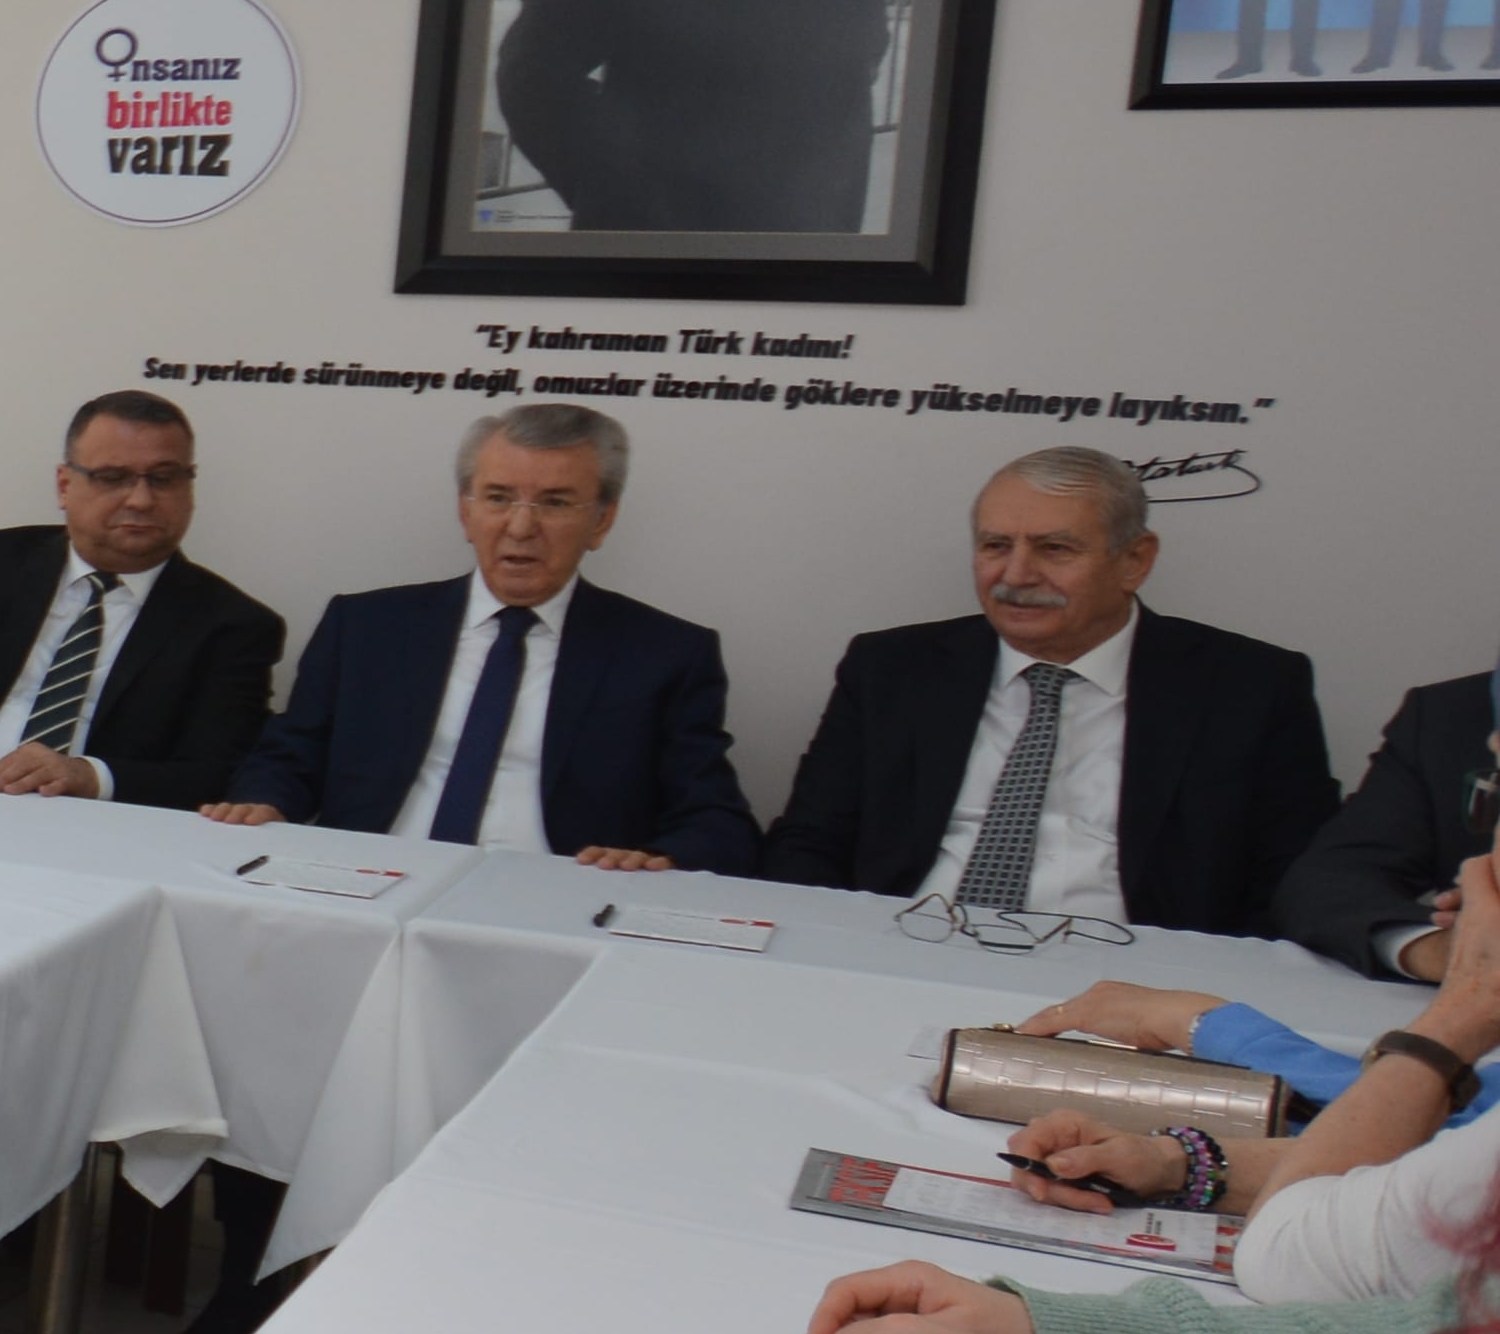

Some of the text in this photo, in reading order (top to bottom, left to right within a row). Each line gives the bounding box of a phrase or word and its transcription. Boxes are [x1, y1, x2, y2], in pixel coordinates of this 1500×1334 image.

[106, 90, 232, 130] birlikte
[107, 133, 232, 177] varız
[527, 326, 668, 353] kahraman
[678, 328, 744, 356] Türk
[750, 331, 855, 360] kadını!
[143, 357, 189, 381] Sen
[191, 359, 296, 386] yerlerde
[303, 362, 447, 395] sürünmeye
[453, 367, 524, 398] değil,
[533, 371, 646, 398] omuzlar
[651, 372, 776, 403] üzerinde
[784, 378, 901, 410] göklere
[906, 383, 1102, 423] yükselmeye
